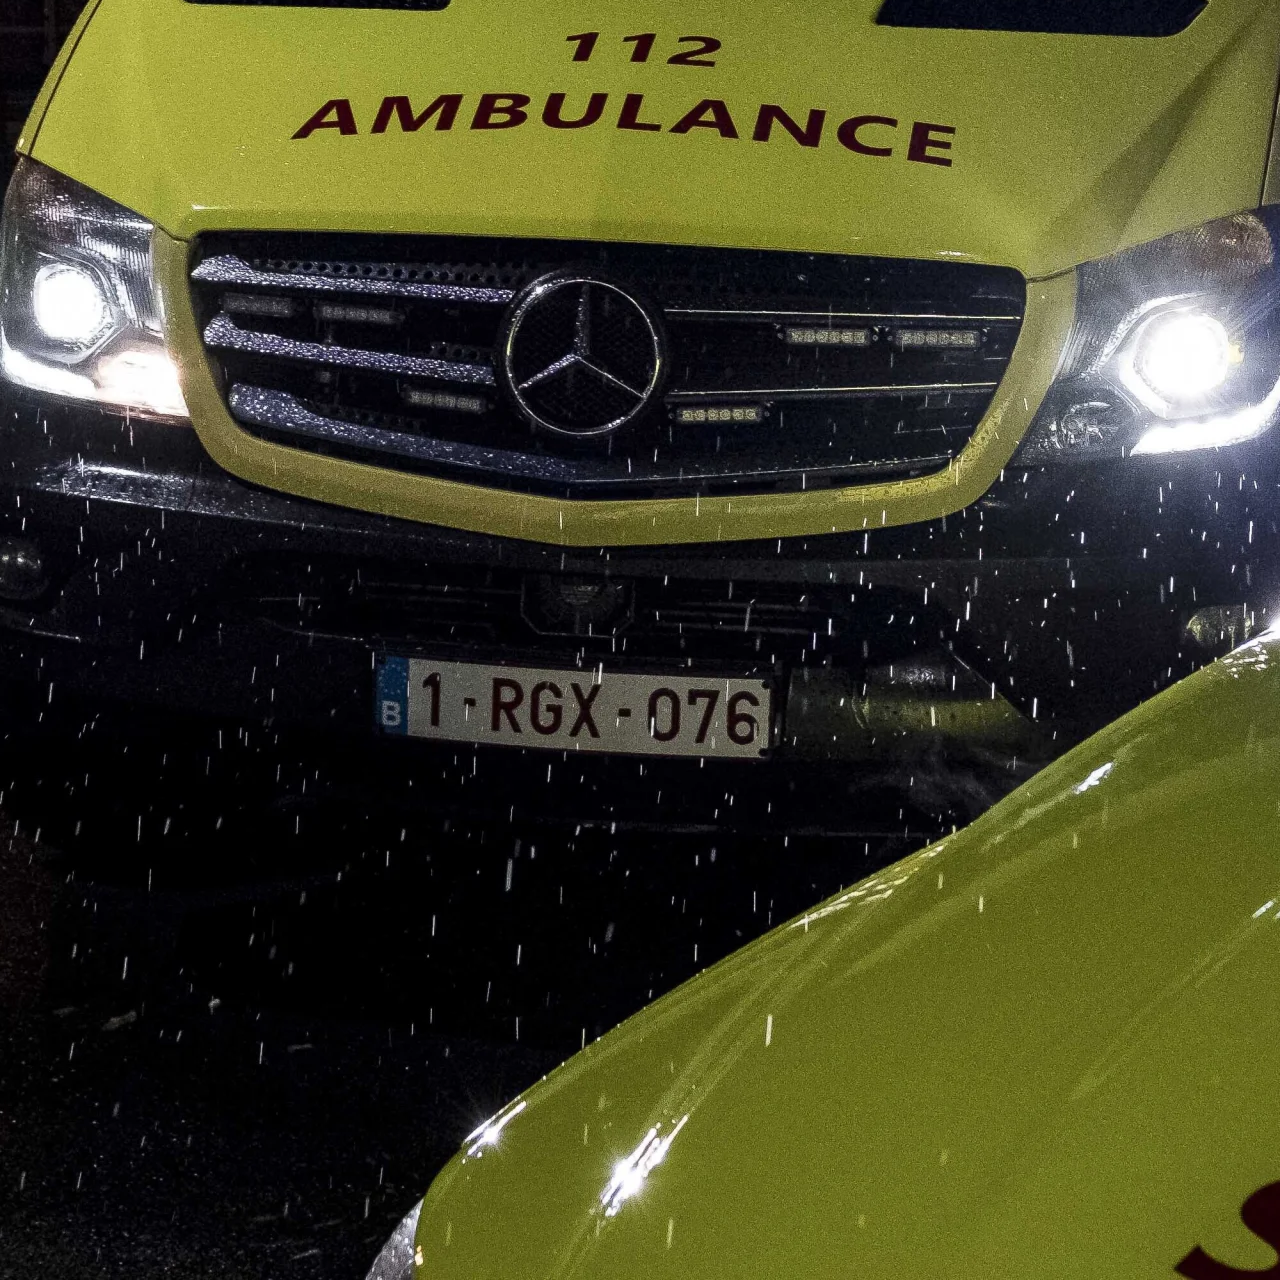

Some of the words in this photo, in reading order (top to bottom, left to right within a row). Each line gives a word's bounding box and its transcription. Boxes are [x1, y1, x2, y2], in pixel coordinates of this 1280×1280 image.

[565, 32, 722, 68] 112
[291, 93, 956, 167] AMBULANCE
[381, 700, 401, 725] B
